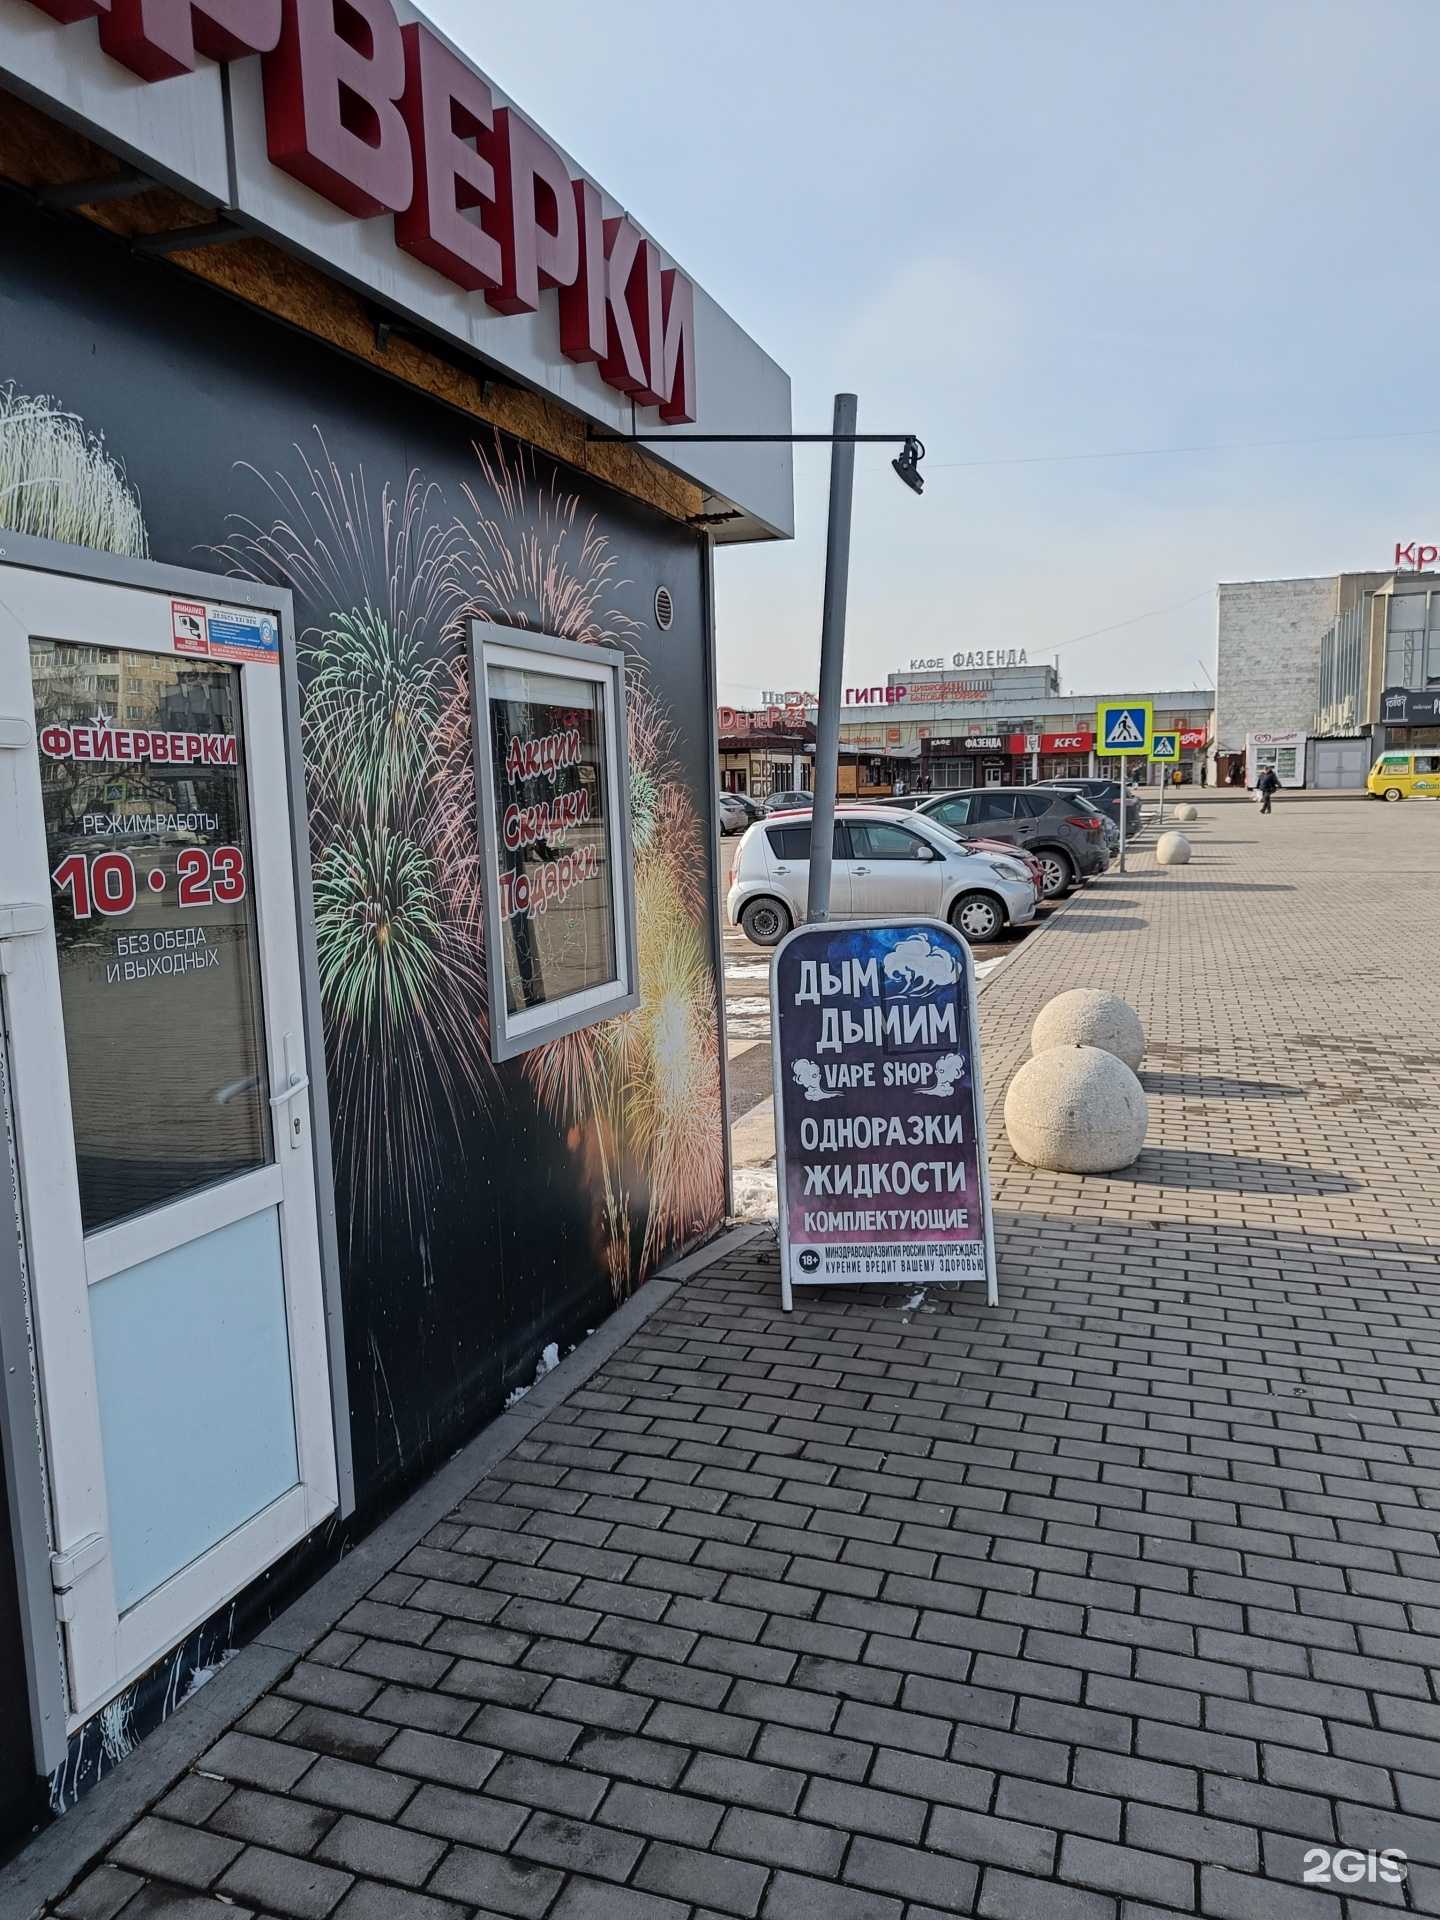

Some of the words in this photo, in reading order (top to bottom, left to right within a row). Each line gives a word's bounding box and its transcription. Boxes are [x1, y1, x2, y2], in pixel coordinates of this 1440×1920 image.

[22, 0, 695, 424] ВЕРКИ
[1395, 542, 1440, 570] Кр
[910, 658, 944, 670] КАФЕ
[952, 648, 1027, 668] ФАЗЕНДА
[845, 686, 907, 704] ГИПЕР
[965, 737, 1001, 748] ФАЗЕНДА
[1054, 738, 1082, 748] KFC
[83, 814, 152, 834] РЕЖИМ
[156, 813, 219, 832] РАБОТЫ
[51, 851, 136, 919] 10
[177, 847, 246, 908] 23
[117, 935, 150, 955] БЕЗ
[153, 928, 207, 951] ОБЕДА
[106, 965, 121, 983] И
[124, 949, 220, 980] ВЫХОДНЫХ
[795, 958, 880, 1005] ДЫМ
[816, 1003, 958, 1054] ДЫМИМ
[824, 1063, 875, 1088] VAPE
[883, 1062, 933, 1086] SHOP
[800, 1115, 963, 1152] ОДНОРАЗКИ
[803, 1161, 967, 1198] ЖИДКОСТИ
[804, 1209, 969, 1232] КОМПЛЕКТУЮЩИЕ
[801, 1255, 818, 1265] 18+
[902, 1243, 926, 1257] РОССИИ
[825, 1261, 861, 1274] КУРЕНИЕ
[865, 1260, 896, 1274] ВРЕДИТ
[901, 1259, 934, 1272] ВАШЕМУ
[940, 1258, 984, 1272] ЗДОРОВЬЮ
